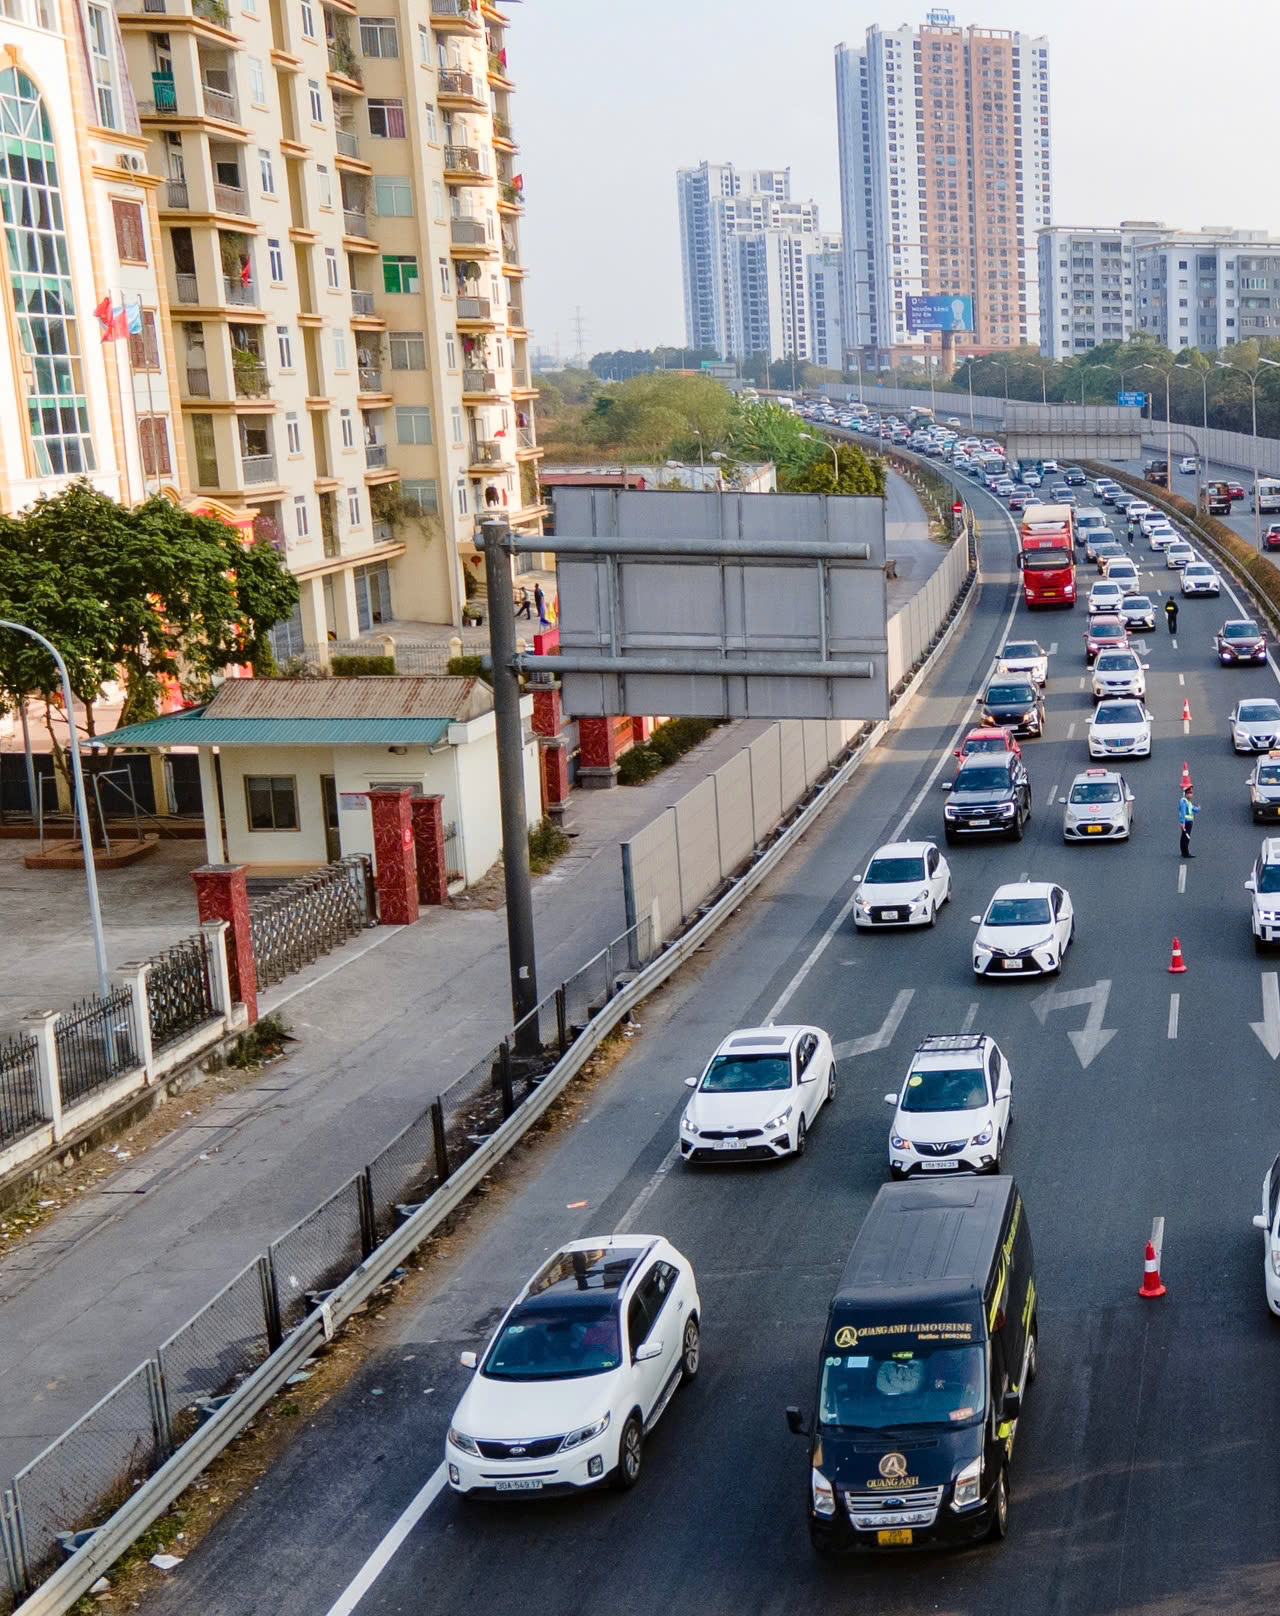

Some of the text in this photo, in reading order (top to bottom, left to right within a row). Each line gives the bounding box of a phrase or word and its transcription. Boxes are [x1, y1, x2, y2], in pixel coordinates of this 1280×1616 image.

[909, 1323, 973, 1333] LIMOUSINE
[866, 1476, 919, 1489] QUANG ANH
